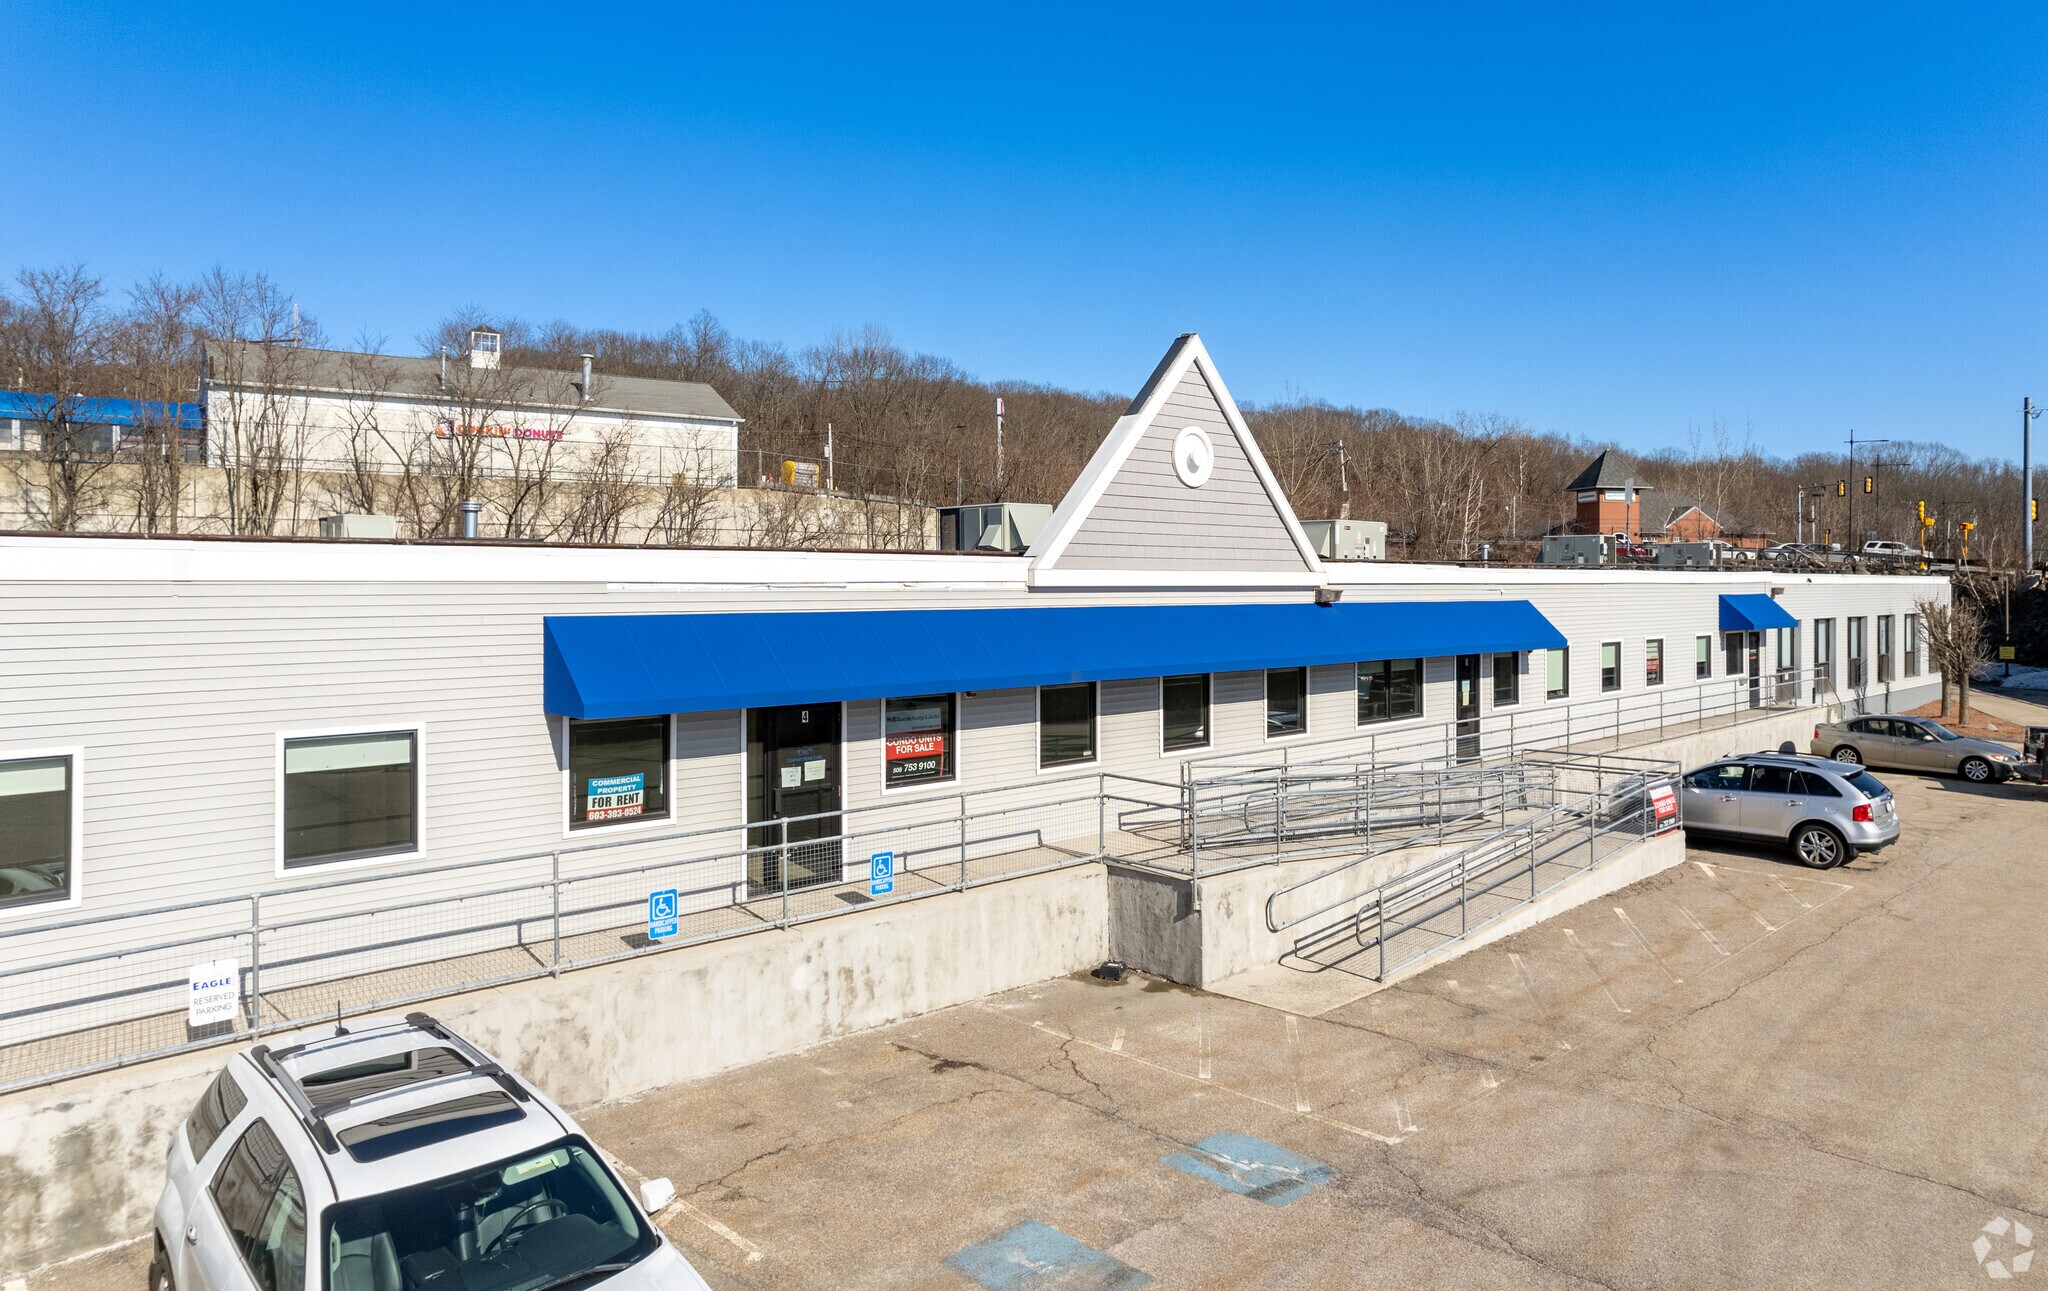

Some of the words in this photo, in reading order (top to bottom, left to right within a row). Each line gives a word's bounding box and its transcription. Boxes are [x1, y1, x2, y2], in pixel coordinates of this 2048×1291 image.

[514, 427, 563, 440] DONUTS
[886, 736, 917, 747] CONDO
[918, 733, 942, 743] UNITS
[896, 745, 913, 754] FOR
[914, 743, 934, 752] SALE
[904, 763, 917, 772] 753
[918, 760, 936, 770] 9100
[592, 776, 641, 787] COMMERCIAL
[597, 784, 637, 794] PROPERTY
[592, 797, 612, 808] FOR
[617, 792, 640, 806] RENT
[589, 806, 642, 820] 603-303-0524
[193, 977, 231, 991] EAGLE
[193, 991, 235, 1006] RESERVED
[196, 1003, 232, 1016] PARKING
